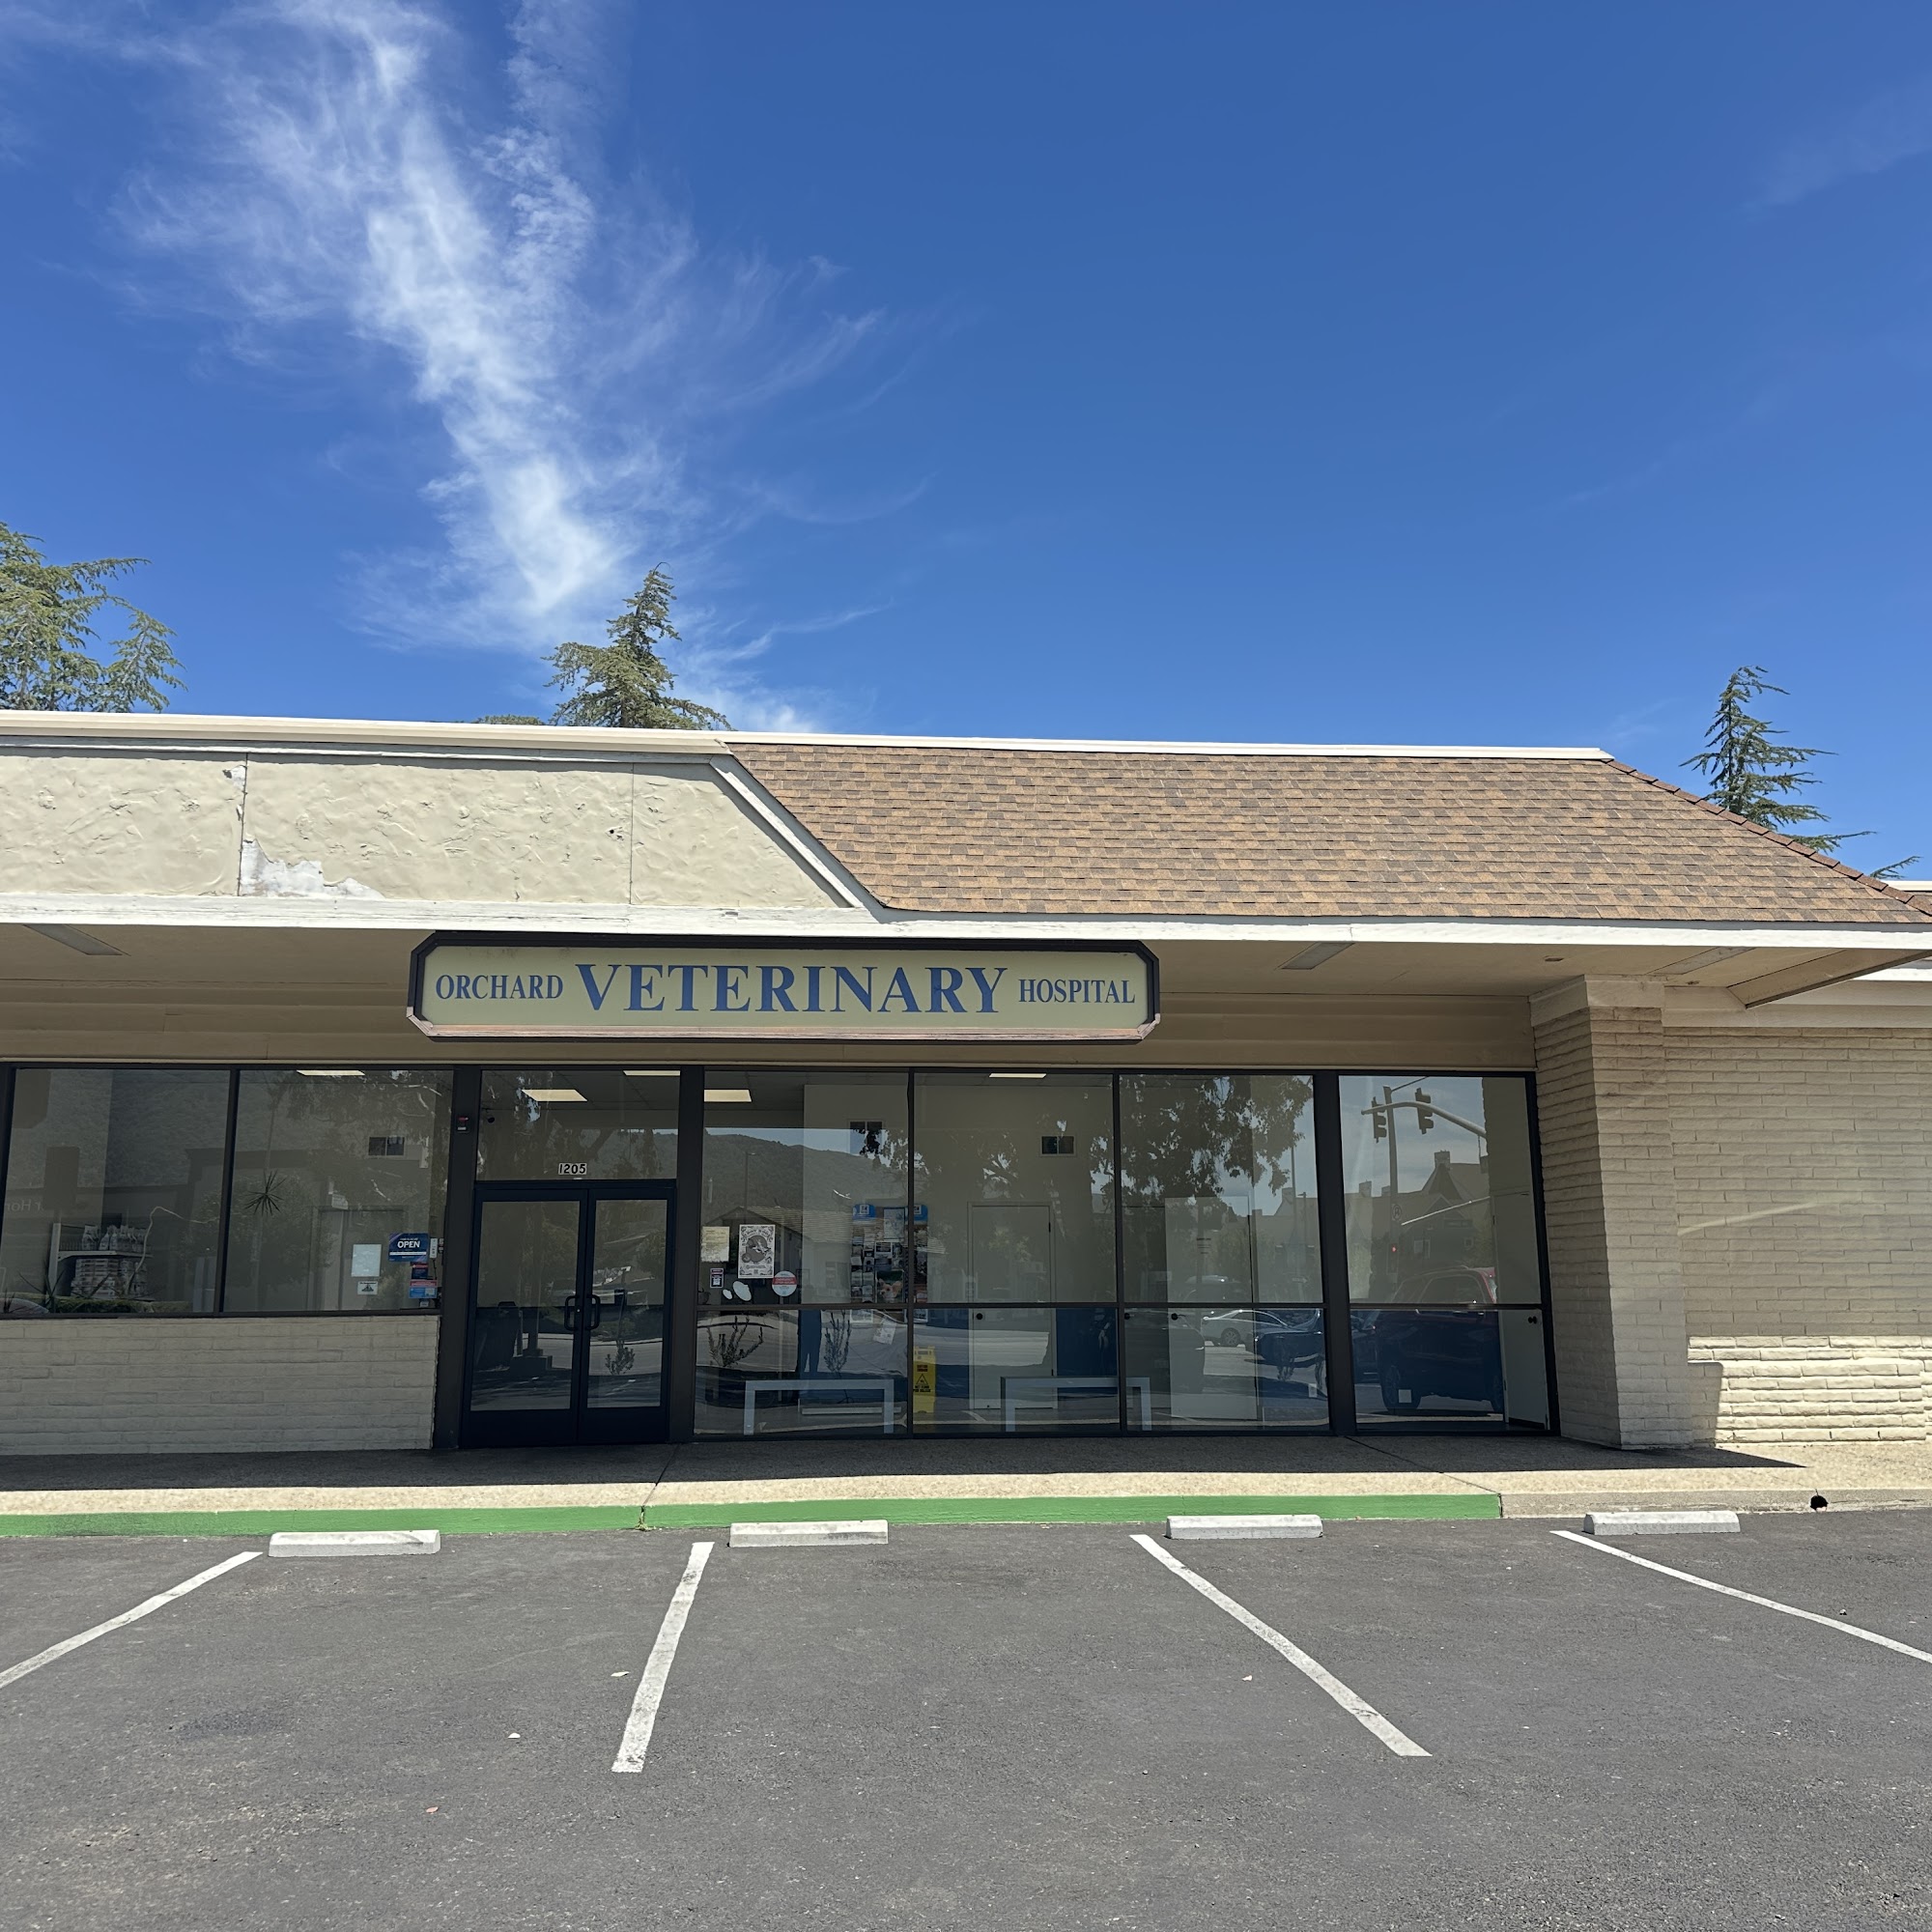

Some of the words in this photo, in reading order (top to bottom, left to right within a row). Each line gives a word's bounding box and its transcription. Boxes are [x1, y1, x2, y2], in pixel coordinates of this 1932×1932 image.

[436, 975, 563, 999] ORCHARD
[575, 964, 1008, 1012] VETERINARY
[1018, 979, 1136, 1004] HOSPITAL
[559, 1164, 585, 1174] 1205
